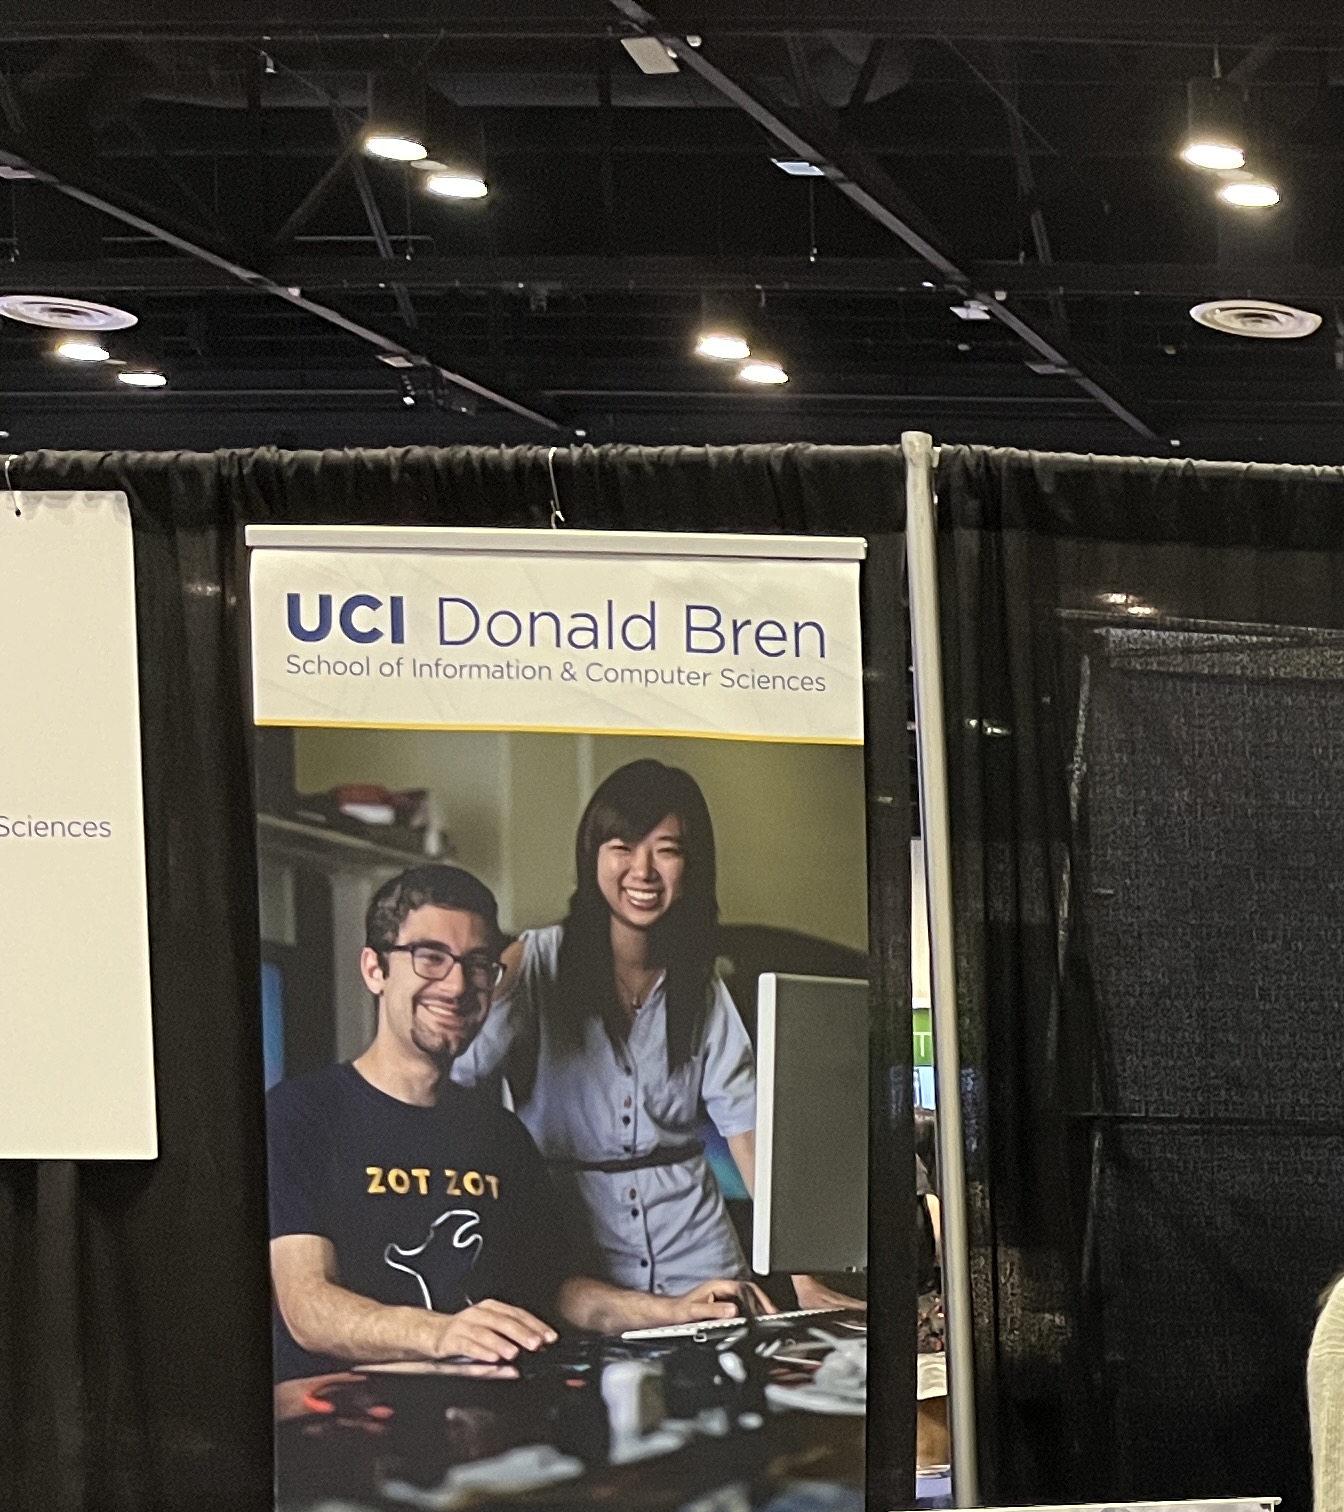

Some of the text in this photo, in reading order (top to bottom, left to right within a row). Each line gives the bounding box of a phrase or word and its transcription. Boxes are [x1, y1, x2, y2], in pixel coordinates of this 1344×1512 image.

[287, 592, 827, 659] UCI Donald Bren
[286, 654, 827, 692] School of Information & Computer Sciences
[0, 814, 112, 838] Sciences
[366, 1166, 500, 1200] ZOT ZOT
